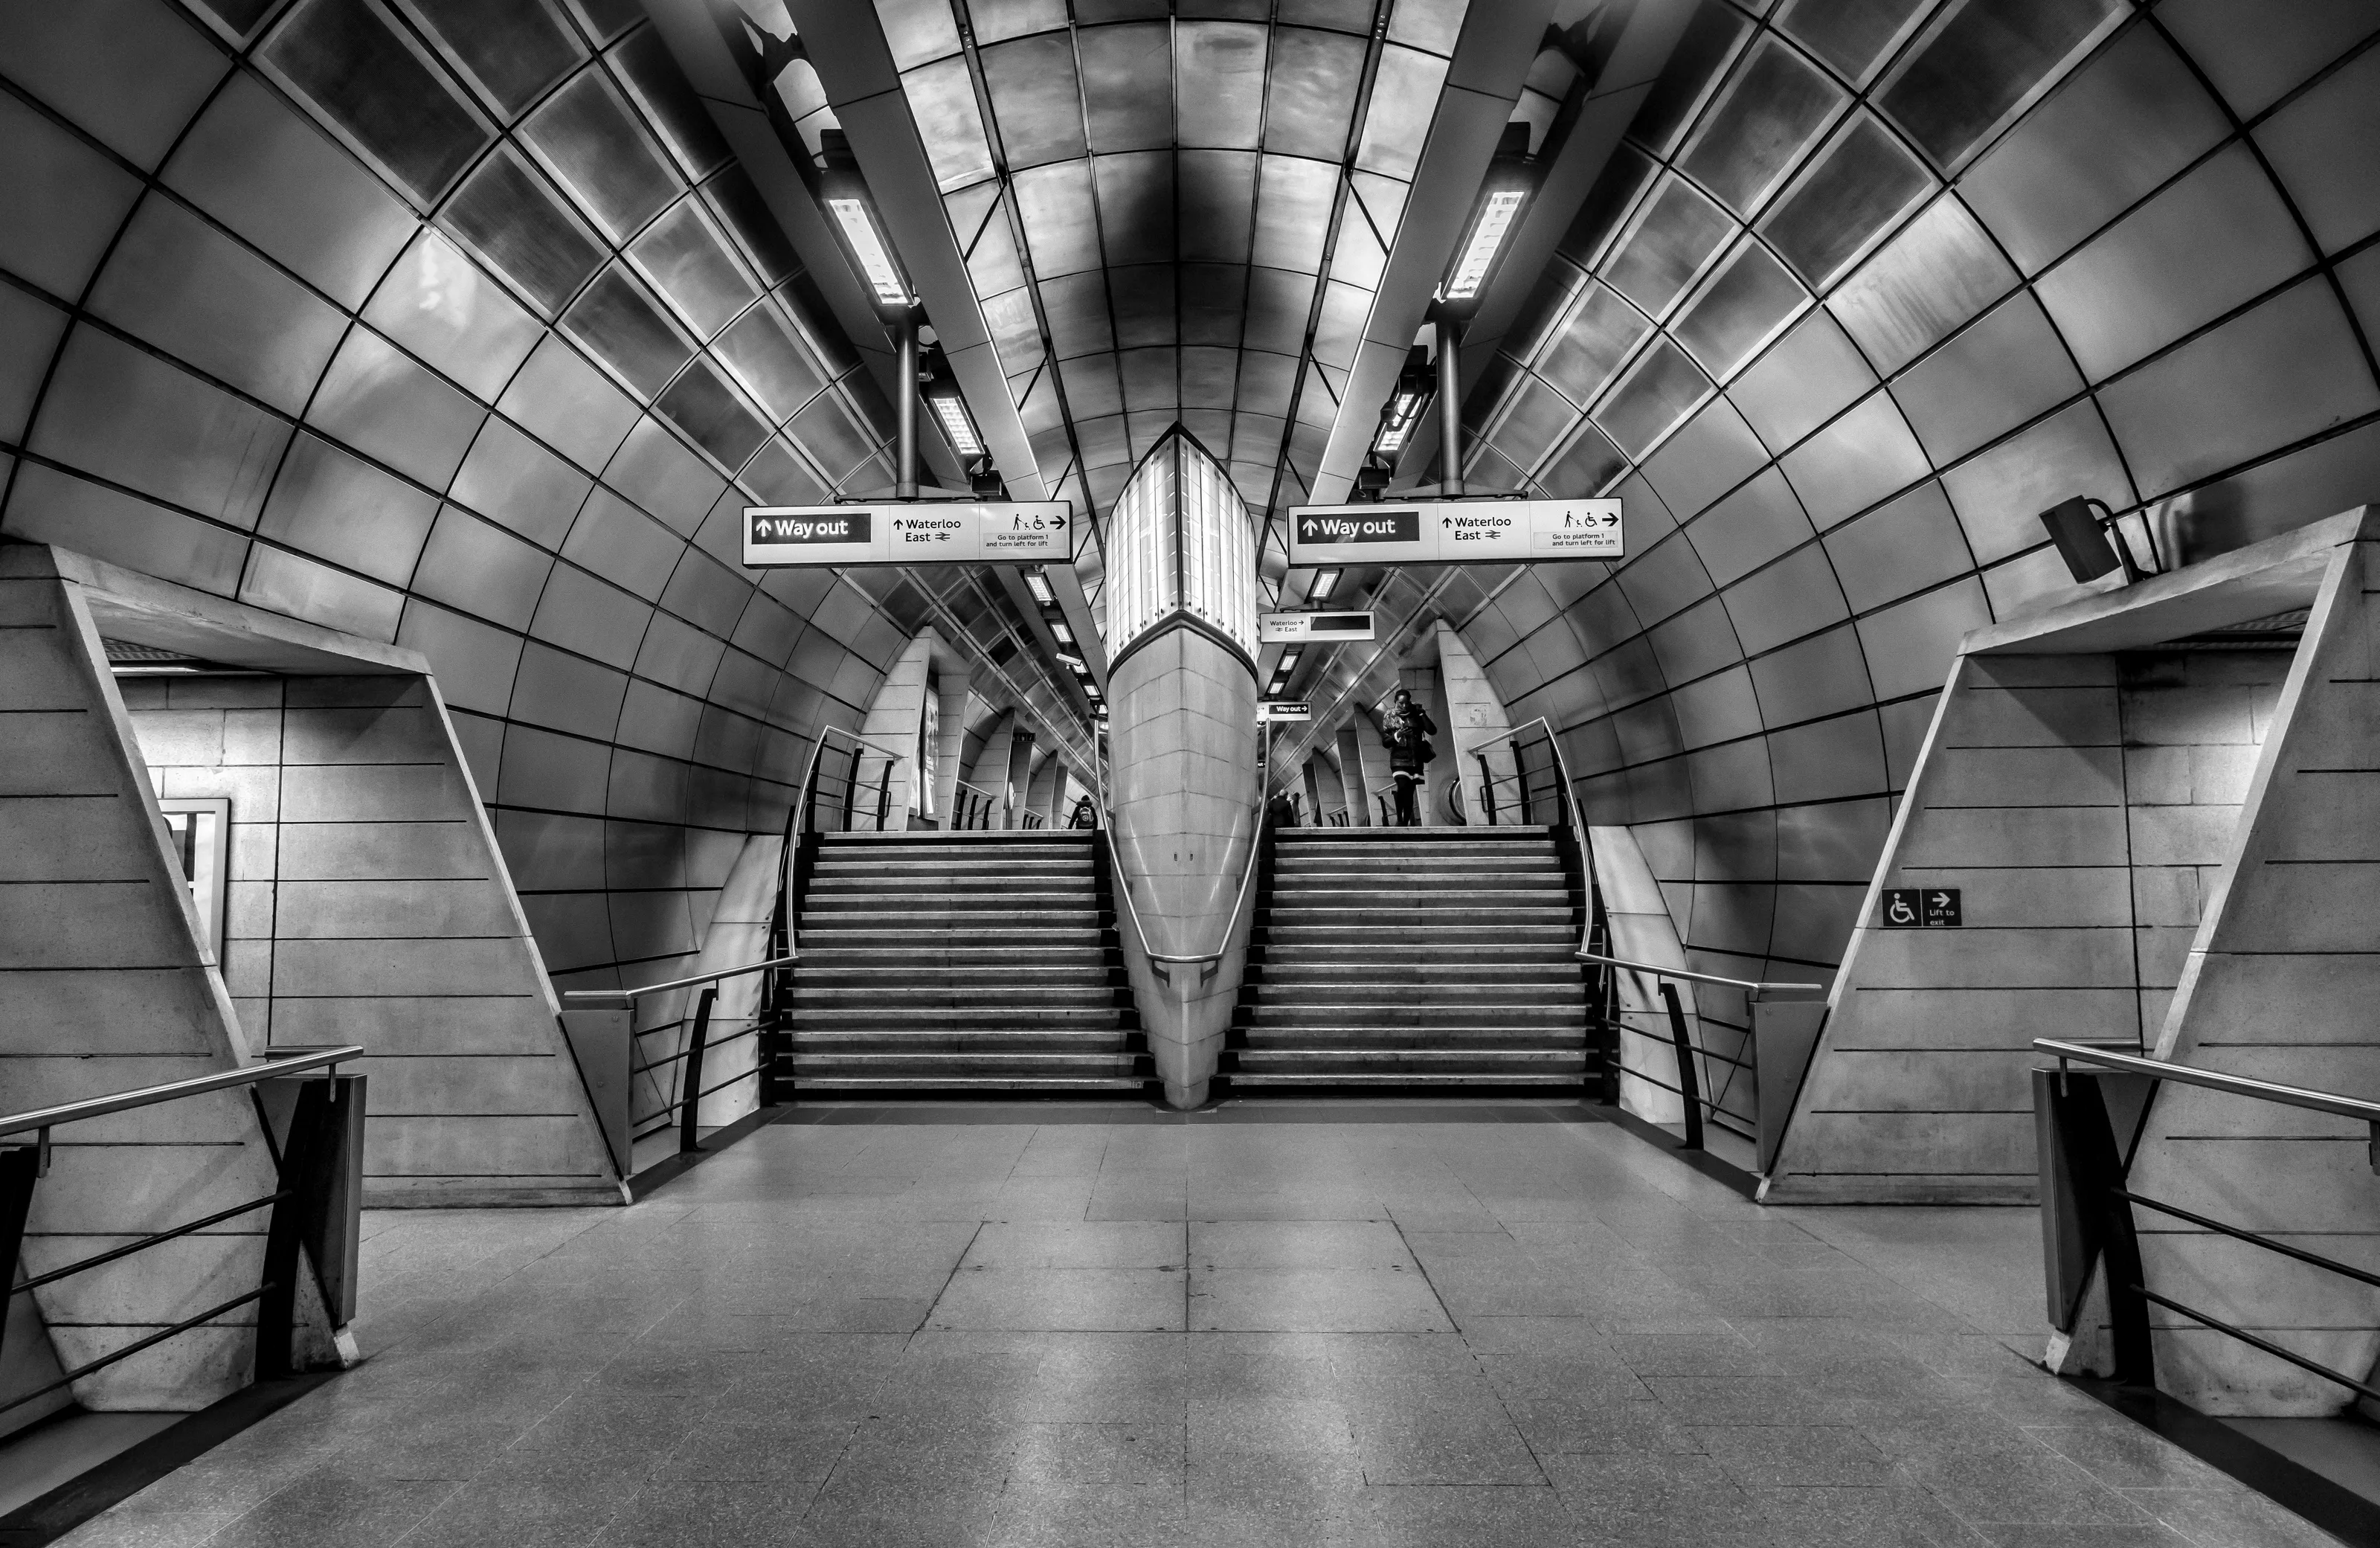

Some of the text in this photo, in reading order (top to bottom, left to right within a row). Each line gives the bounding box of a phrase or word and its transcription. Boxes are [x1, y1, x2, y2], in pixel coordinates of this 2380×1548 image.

[906, 519, 962, 530] Waterloo
[1455, 516, 1511, 527] Waterloo
[774, 520, 849, 539] Way out
[1321, 519, 1396, 538] Way out
[906, 532, 931, 542] East
[1455, 530, 1481, 541] East
